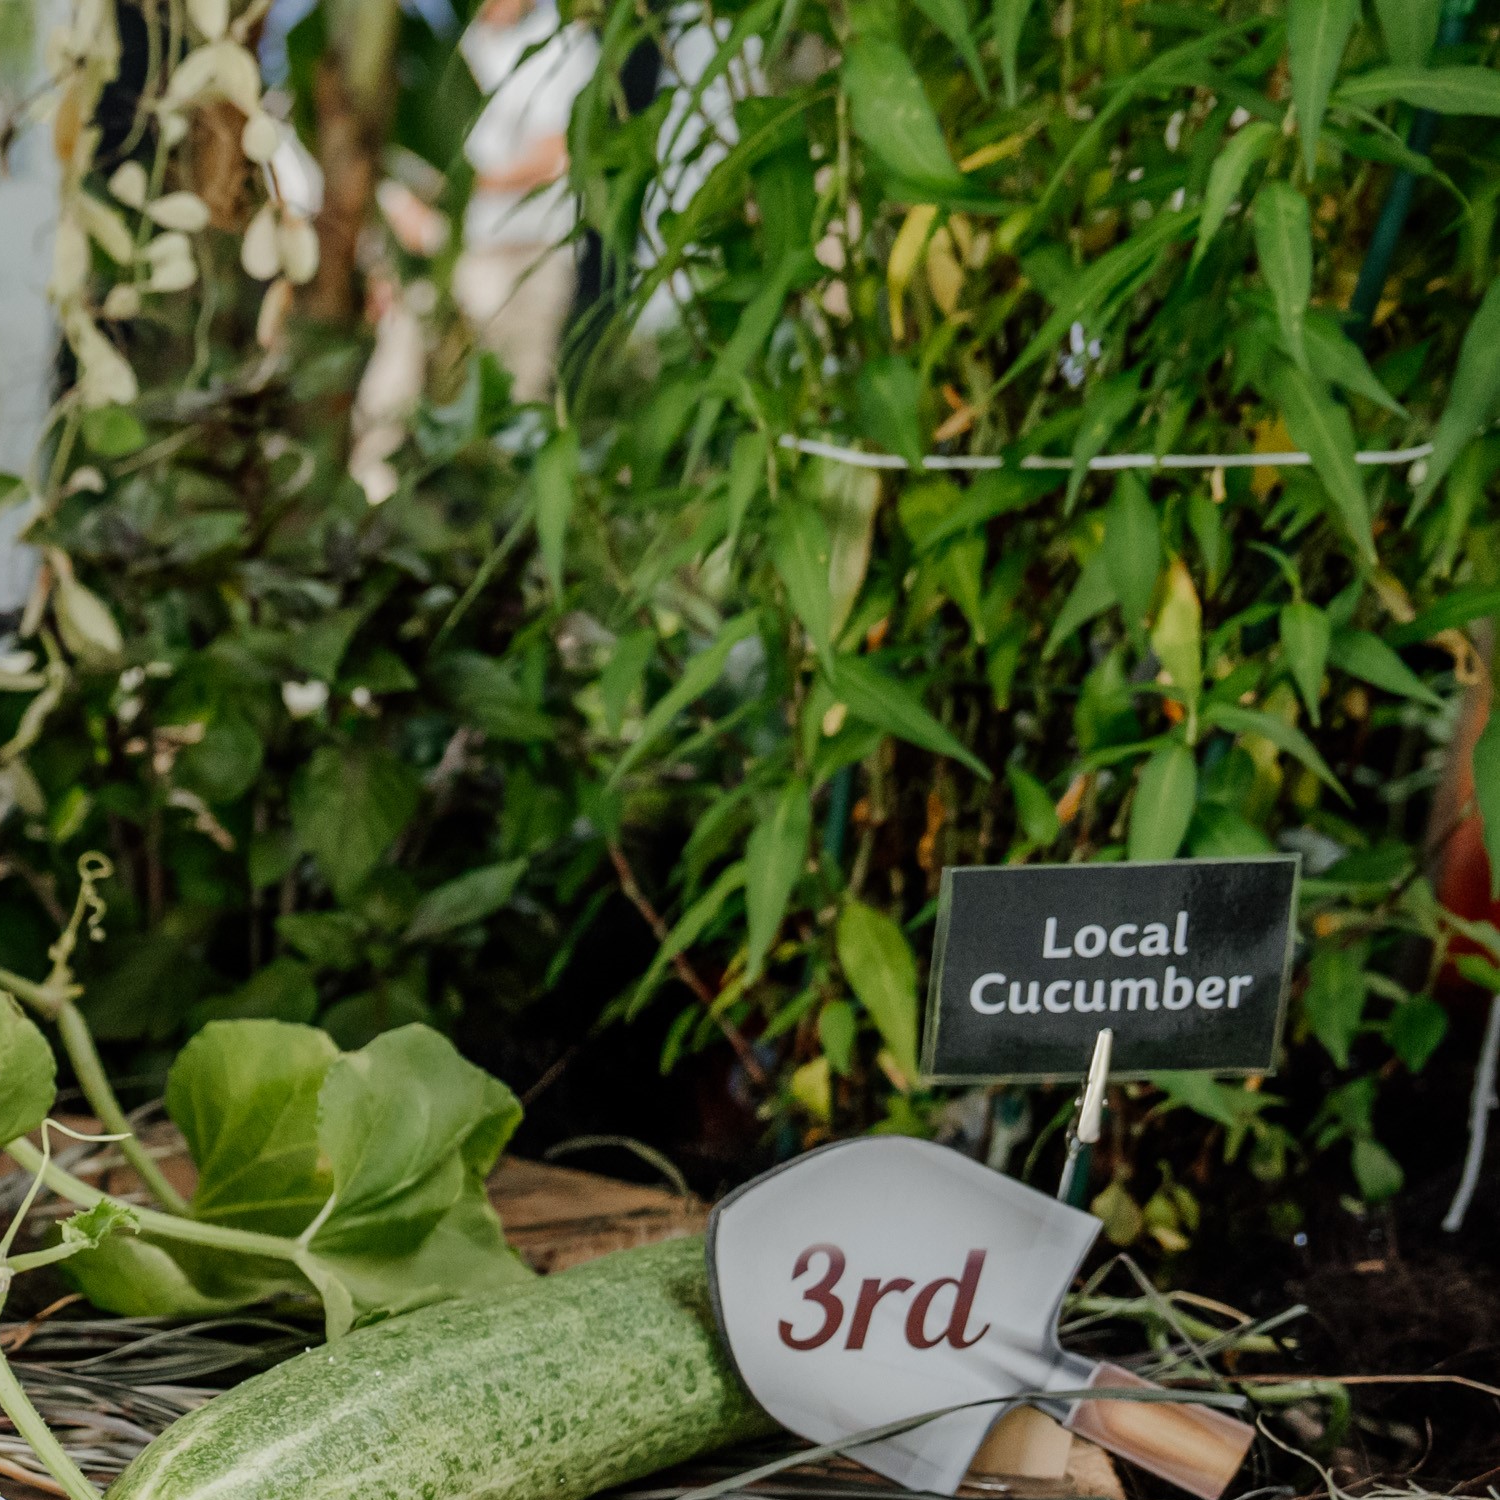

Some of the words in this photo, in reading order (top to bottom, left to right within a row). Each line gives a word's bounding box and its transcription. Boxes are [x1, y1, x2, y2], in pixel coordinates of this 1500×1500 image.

[1042, 910, 1189, 959] Local
[969, 965, 1253, 1015] Cucumber
[778, 1243, 991, 1351] 3rd
